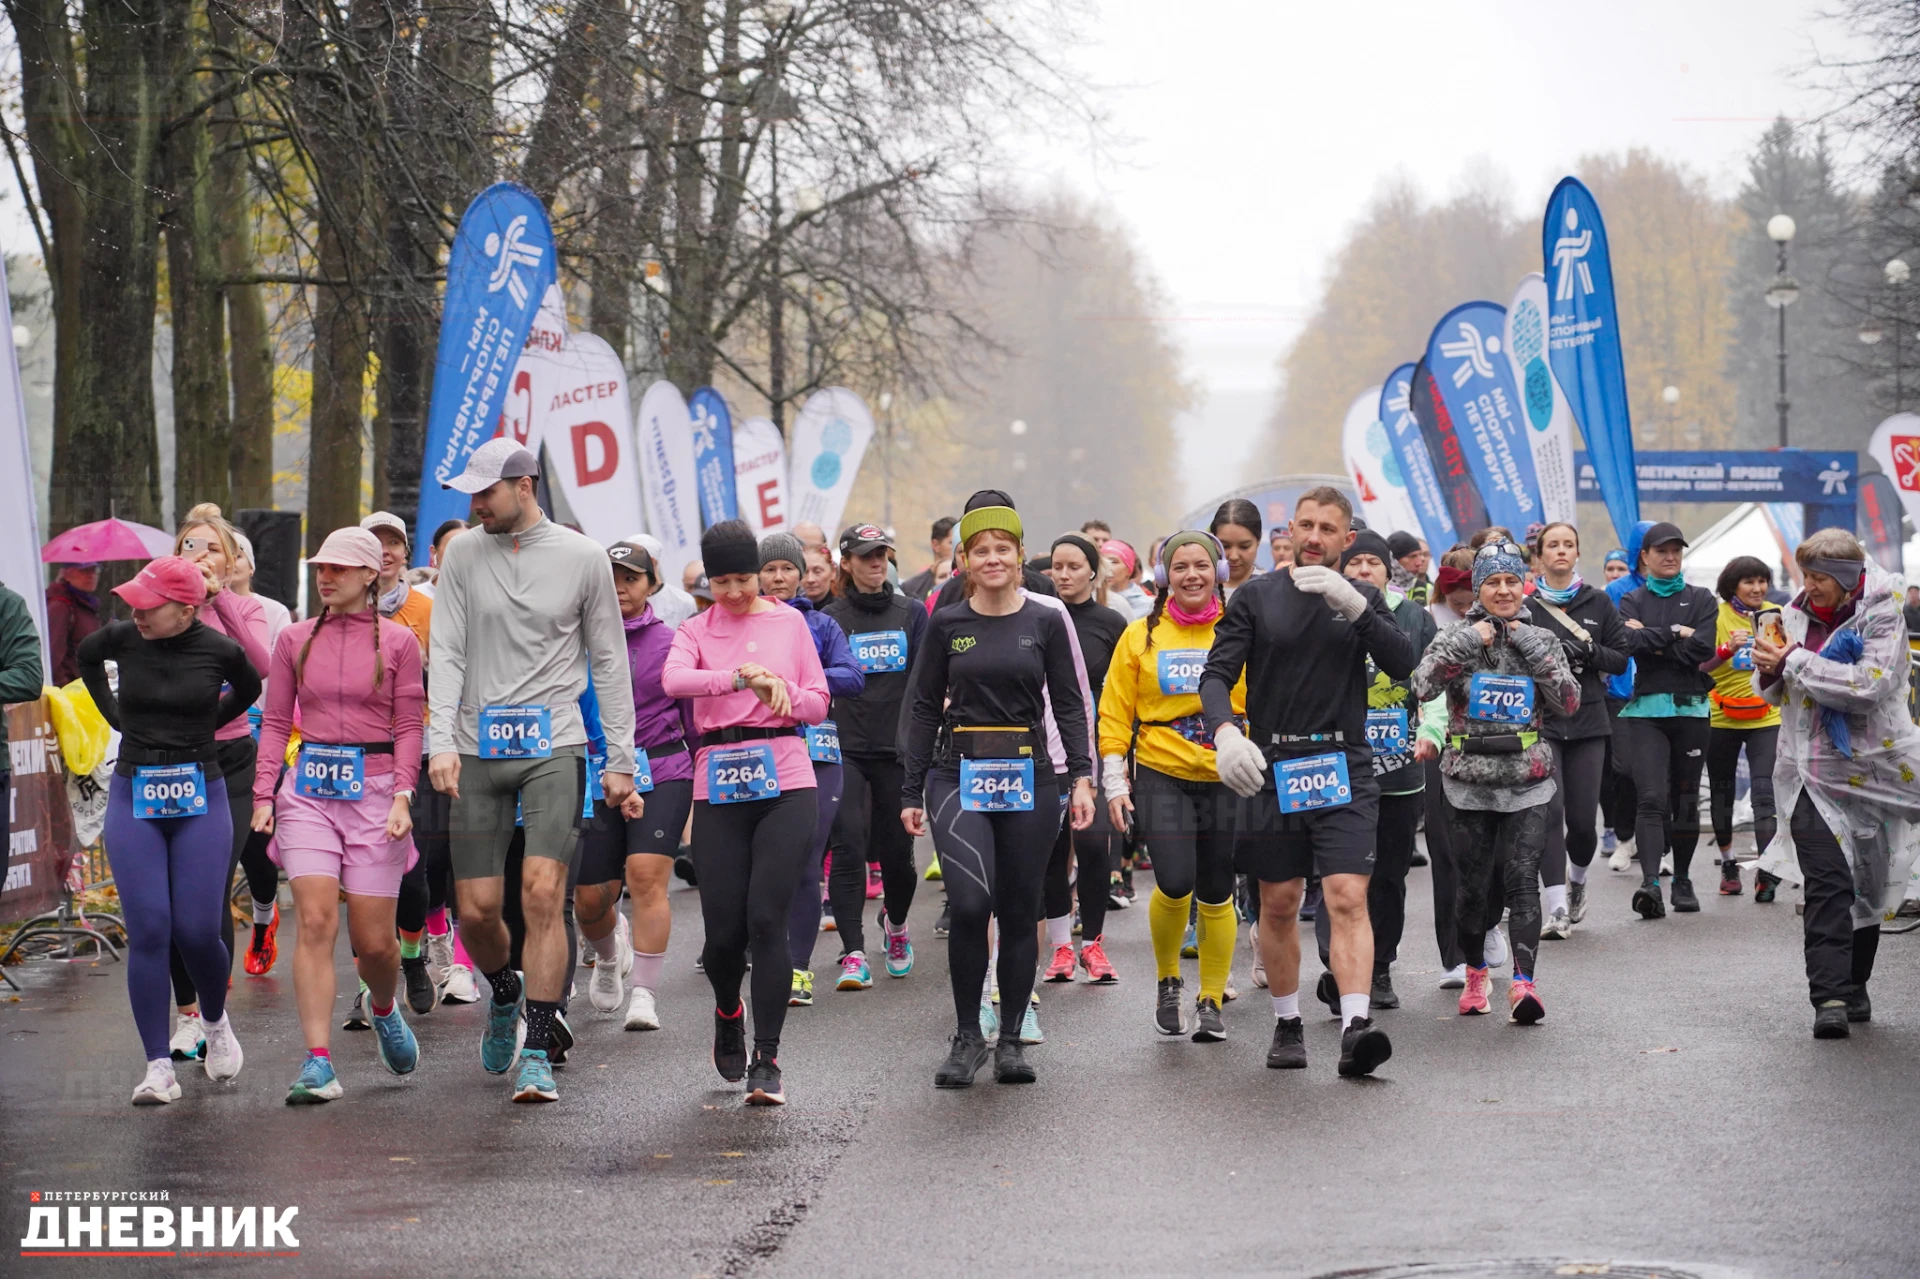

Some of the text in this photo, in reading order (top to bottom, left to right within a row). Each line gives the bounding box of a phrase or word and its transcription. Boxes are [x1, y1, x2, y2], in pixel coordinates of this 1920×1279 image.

[549, 381, 618, 411] ЛАСТЕР
[1491, 386, 1512, 419] МЫ
[570, 421, 619, 487] D
[1464, 401, 1509, 492] ПЕТЕРБУРГ
[1478, 394, 1534, 513] СПОРТИВНЫЙ
[757, 479, 784, 529] E
[859, 644, 900, 659] 8056
[1167, 663, 1205, 679] 209
[1478, 690, 1525, 707] 2702
[488, 722, 541, 740] 6014
[1365, 725, 1400, 740] 676
[305, 762, 354, 781] 6015
[715, 764, 767, 785] 2264
[143, 781, 196, 800] 6009
[970, 777, 1024, 794] 2644
[1286, 771, 1339, 794] 2004
